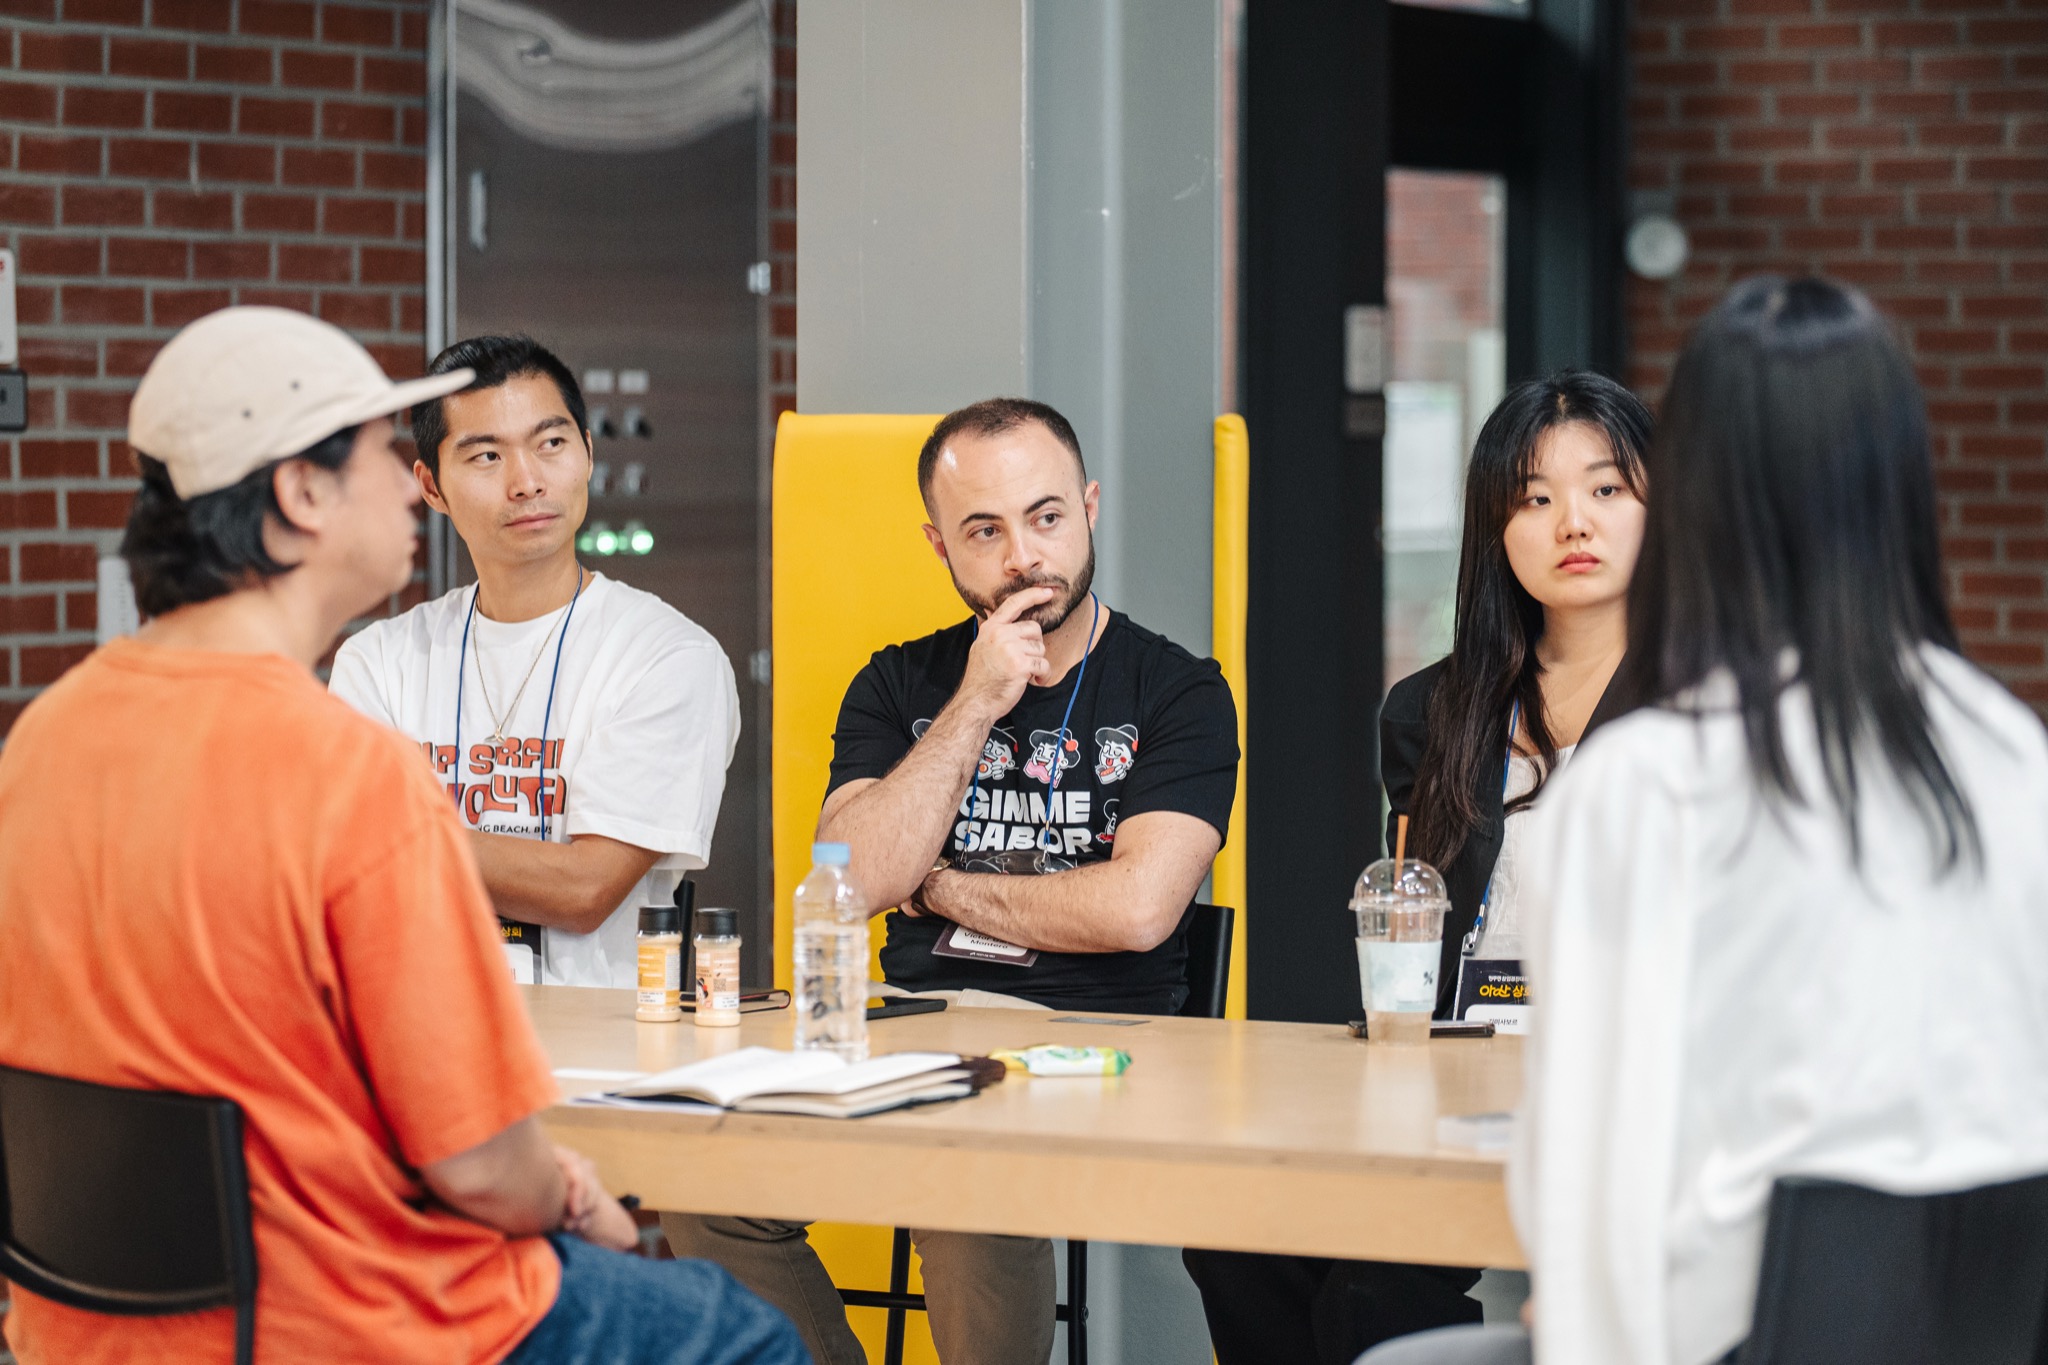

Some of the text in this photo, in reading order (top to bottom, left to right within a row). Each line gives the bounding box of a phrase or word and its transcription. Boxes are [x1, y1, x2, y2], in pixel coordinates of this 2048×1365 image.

[959, 785, 1091, 824] GIMME
[493, 824, 531, 834] BEACH,
[954, 820, 1094, 855] SABOR
[970, 939, 1008, 949] Montero
[1479, 985, 1511, 998] 아산
